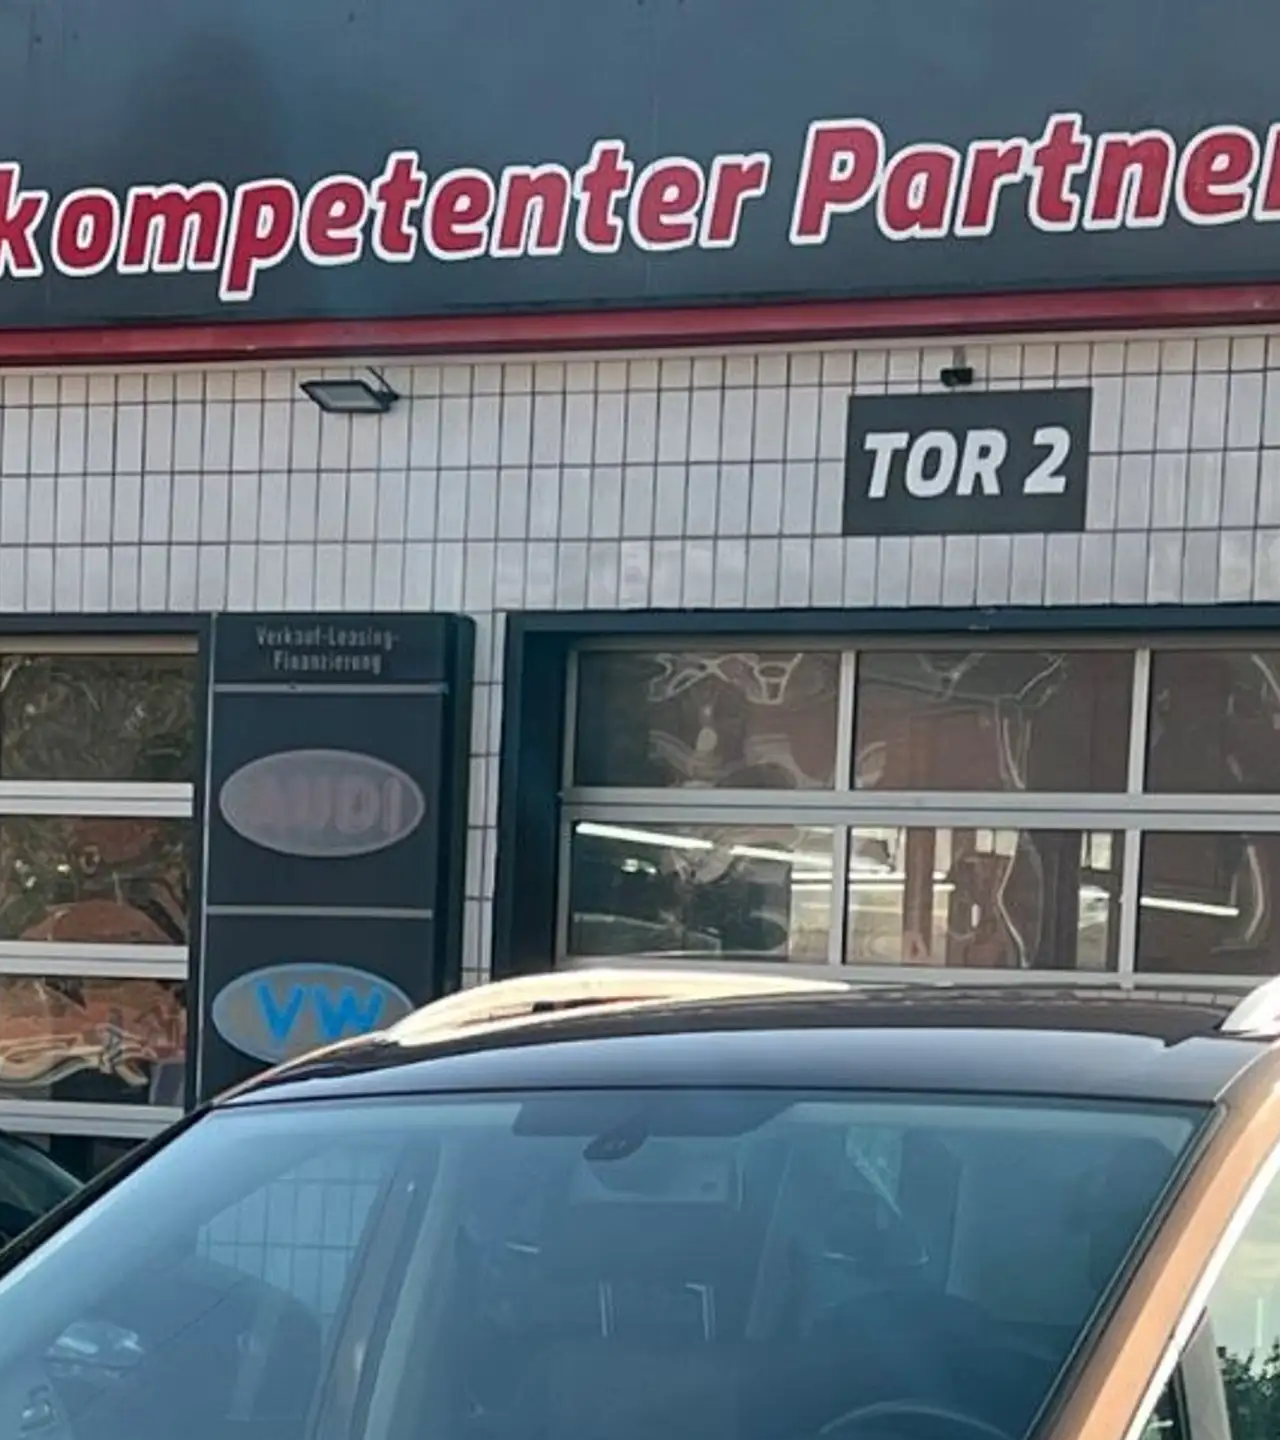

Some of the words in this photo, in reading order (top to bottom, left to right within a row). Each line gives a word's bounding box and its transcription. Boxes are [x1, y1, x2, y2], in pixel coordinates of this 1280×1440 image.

[863, 427, 1006, 498] TOR
[1024, 426, 1071, 494] 2
[273, 650, 382, 676] Finanzierung
[256, 980, 383, 1042] VW
